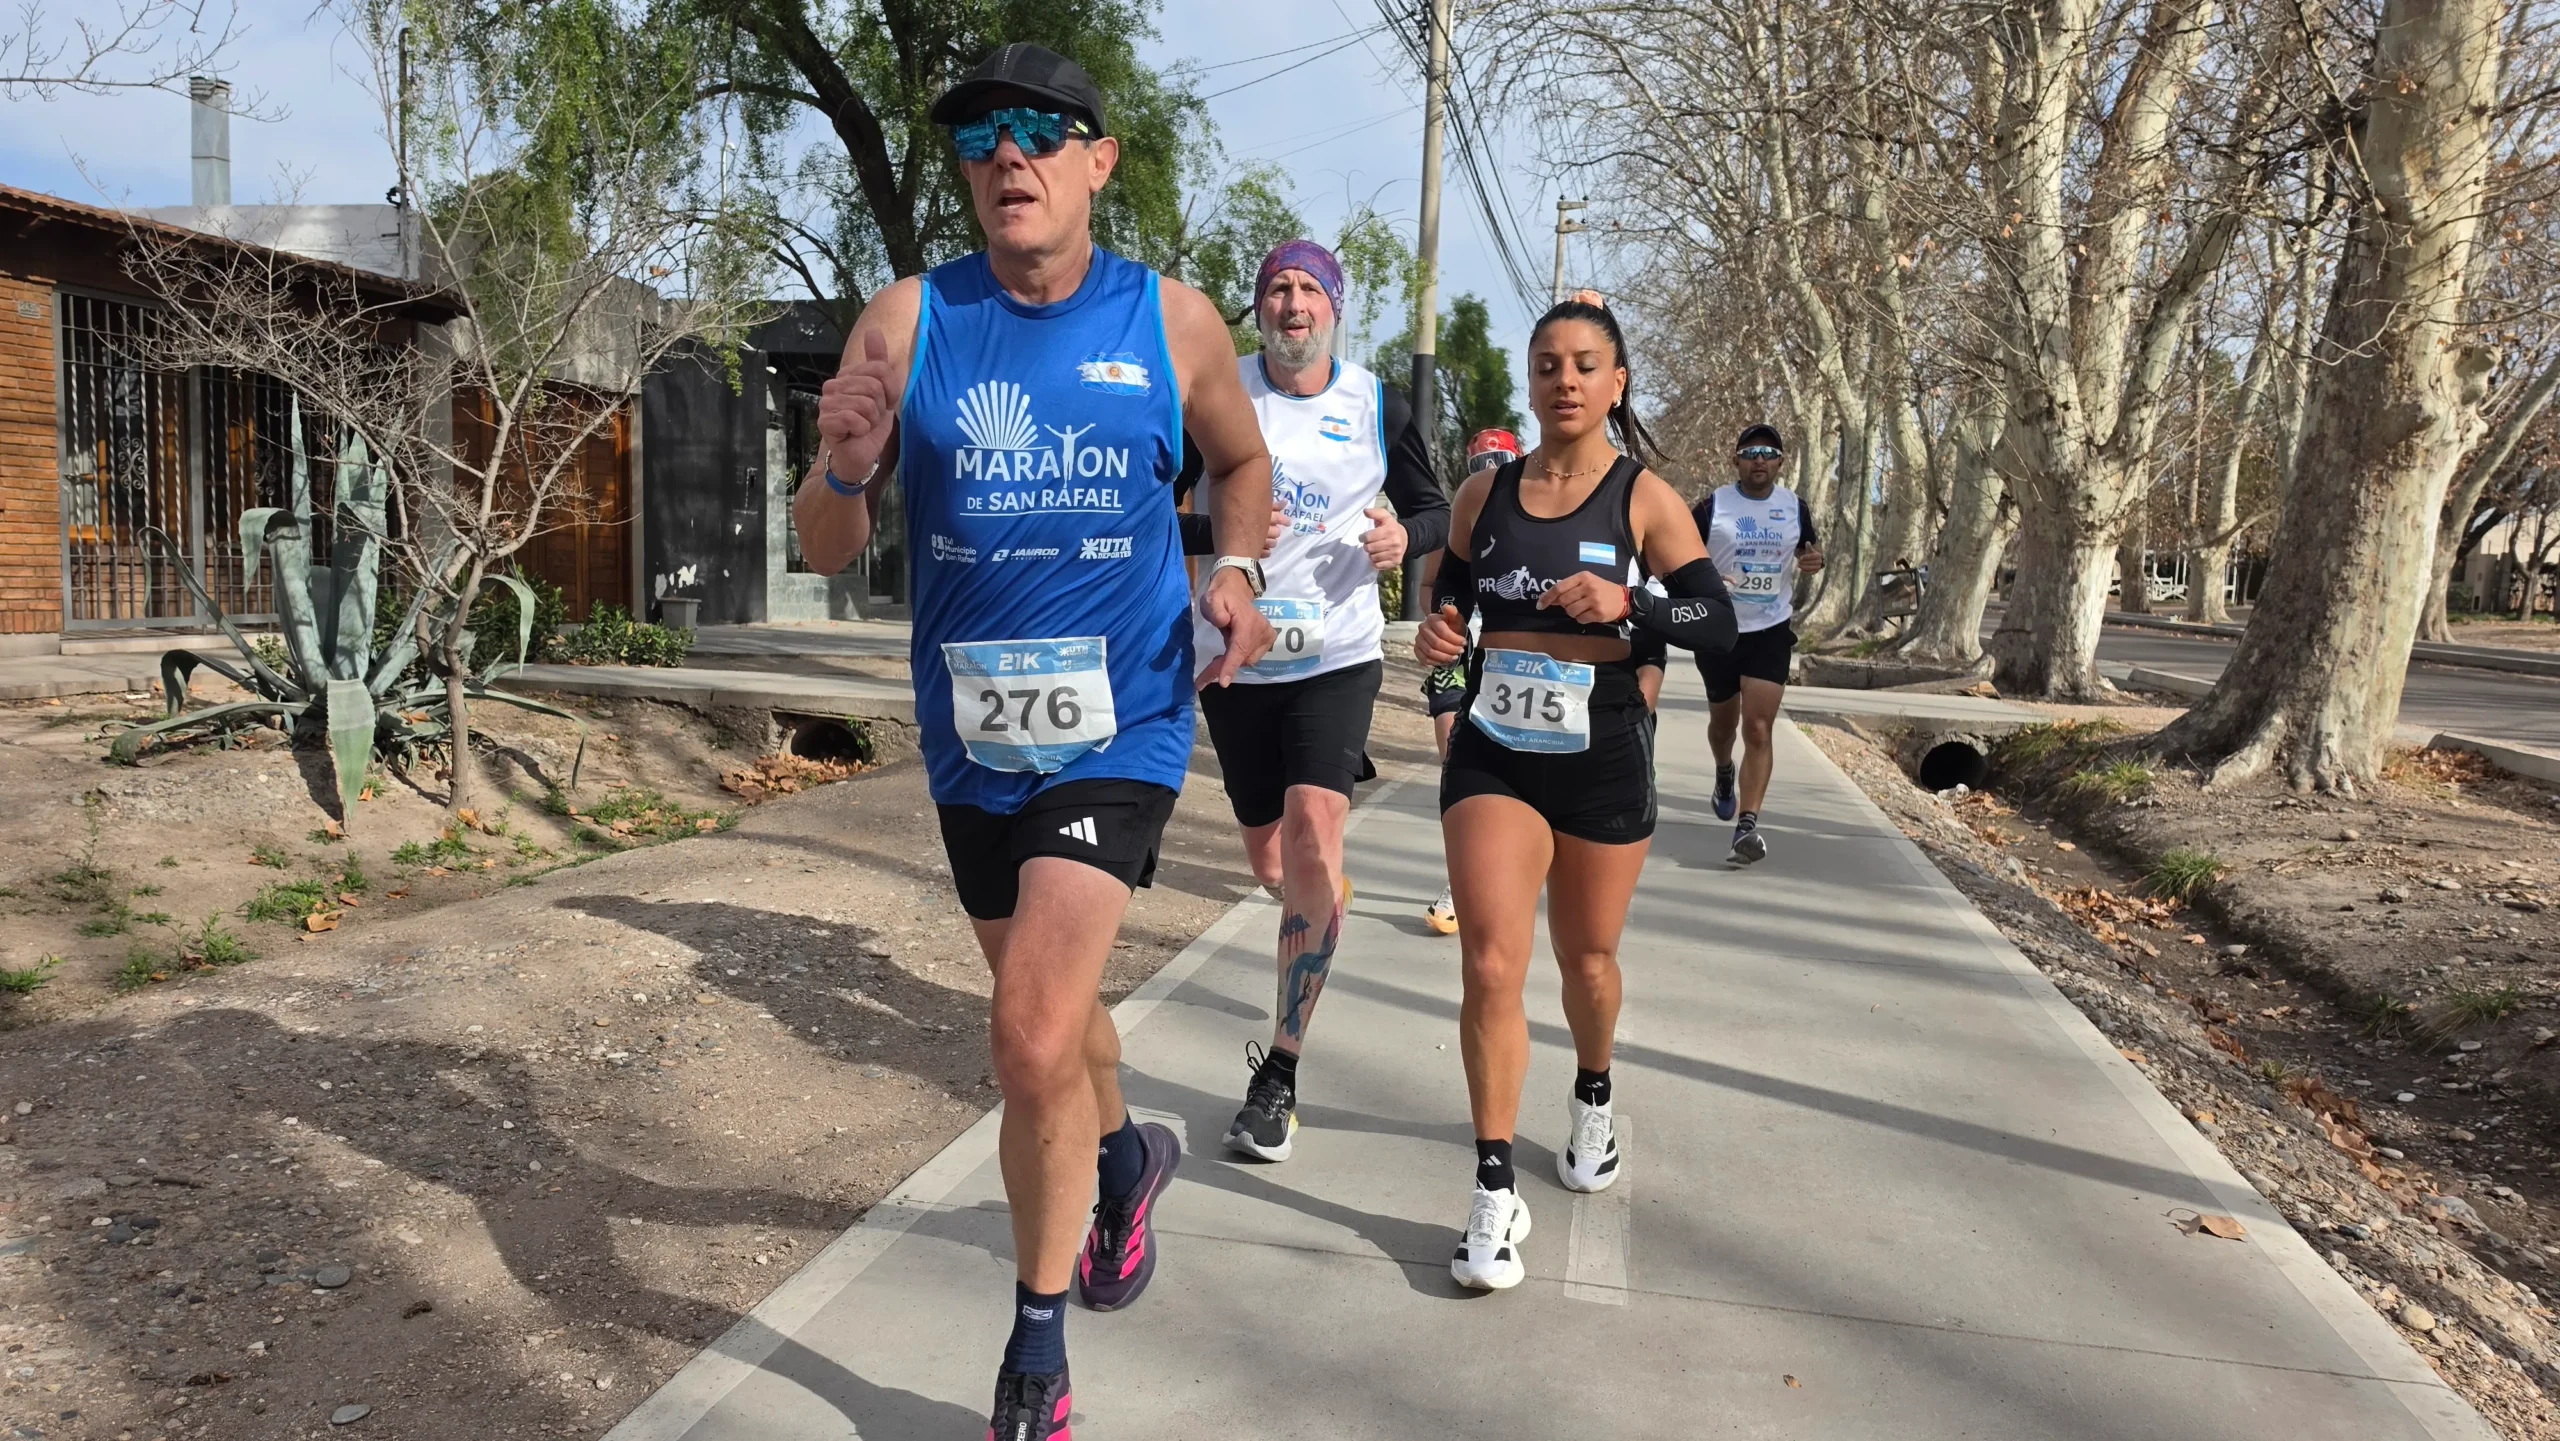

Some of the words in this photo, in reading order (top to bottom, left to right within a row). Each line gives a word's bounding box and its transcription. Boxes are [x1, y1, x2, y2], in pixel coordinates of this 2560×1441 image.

[955, 446, 1129, 482] MARATON
[967, 496, 983, 510] DE
[988, 491, 1036, 511] SAN
[1041, 488, 1122, 509] RAFAEL
[1272, 489, 1330, 509] RATON
[1284, 509, 1324, 523] RAFAEL
[1736, 531, 1782, 540] MARATON
[945, 544, 977, 556] Municipio
[1011, 548, 1060, 556] JAMROD
[1099, 536, 1133, 552] UTN
[1739, 576, 1773, 590] 298
[1259, 605, 1286, 617] 21K
[998, 651, 1042, 671] 21K
[1514, 659, 1548, 675] 21K
[979, 686, 1083, 732] 276
[1490, 683, 1566, 723] 315
